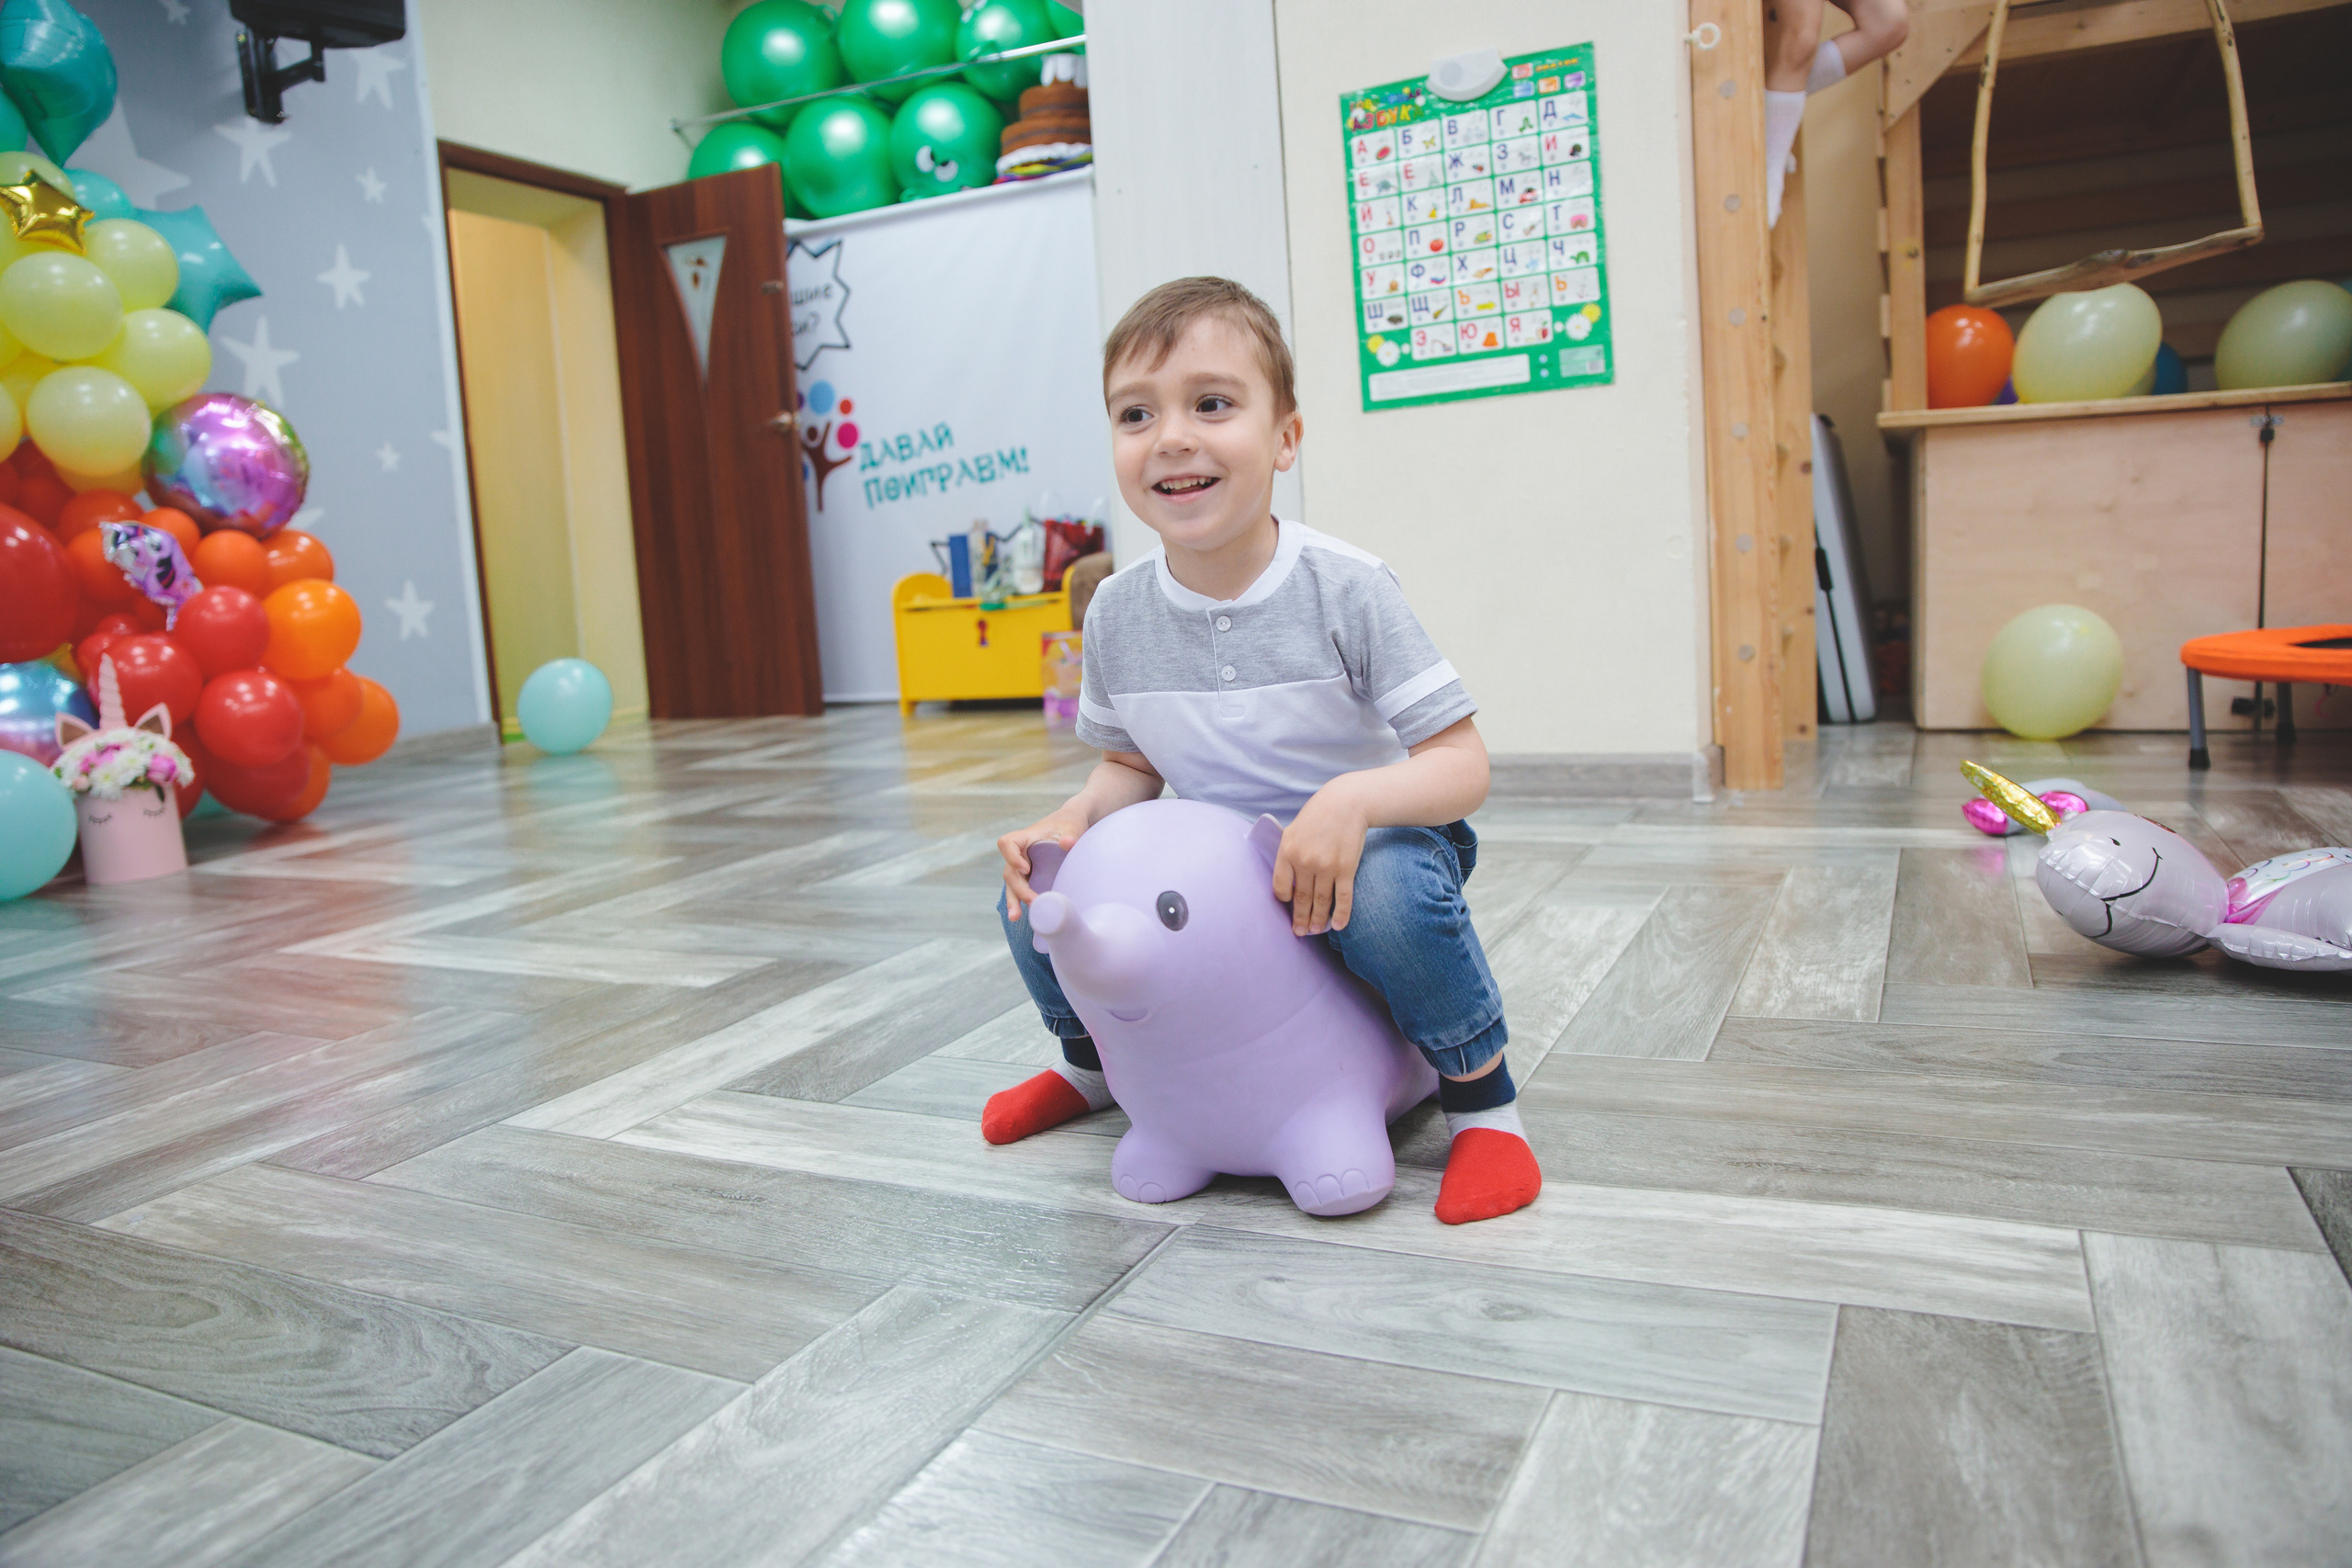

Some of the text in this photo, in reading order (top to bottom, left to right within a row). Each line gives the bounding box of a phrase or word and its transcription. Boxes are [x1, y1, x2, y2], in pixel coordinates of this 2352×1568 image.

[1351, 104, 1424, 131] АЗБУКА
[1357, 140, 1367, 154] А
[1402, 130, 1412, 144] Б
[1448, 119, 1458, 135] В
[1497, 109, 1505, 126] Г
[1544, 100, 1556, 120] Д
[1359, 172, 1369, 186] Е
[1449, 152, 1464, 169] Ж
[1498, 144, 1508, 160] З
[1545, 135, 1557, 151] И
[1407, 196, 1418, 211] К
[1452, 186, 1463, 203] Л
[1500, 178, 1515, 195] М
[1549, 170, 1560, 186] Н
[1363, 238, 1374, 254] О
[1409, 230, 1420, 245] П
[1454, 221, 1465, 237] Р
[1503, 213, 1514, 230] С
[1552, 205, 1562, 221] Т
[1366, 271, 1375, 287] У
[1410, 264, 1425, 278] Ф
[1457, 255, 1468, 272] Х
[1504, 248, 1517, 265] Ц
[1553, 240, 1565, 255] Ч
[1367, 303, 1384, 319] Ш
[1411, 296, 1430, 313] Щ
[1504, 282, 1521, 299] Ы
[1555, 276, 1566, 291] Ь
[1460, 323, 1477, 340] Ю
[1510, 317, 1521, 333] Я
[859, 420, 955, 473] ДАВАЙ
